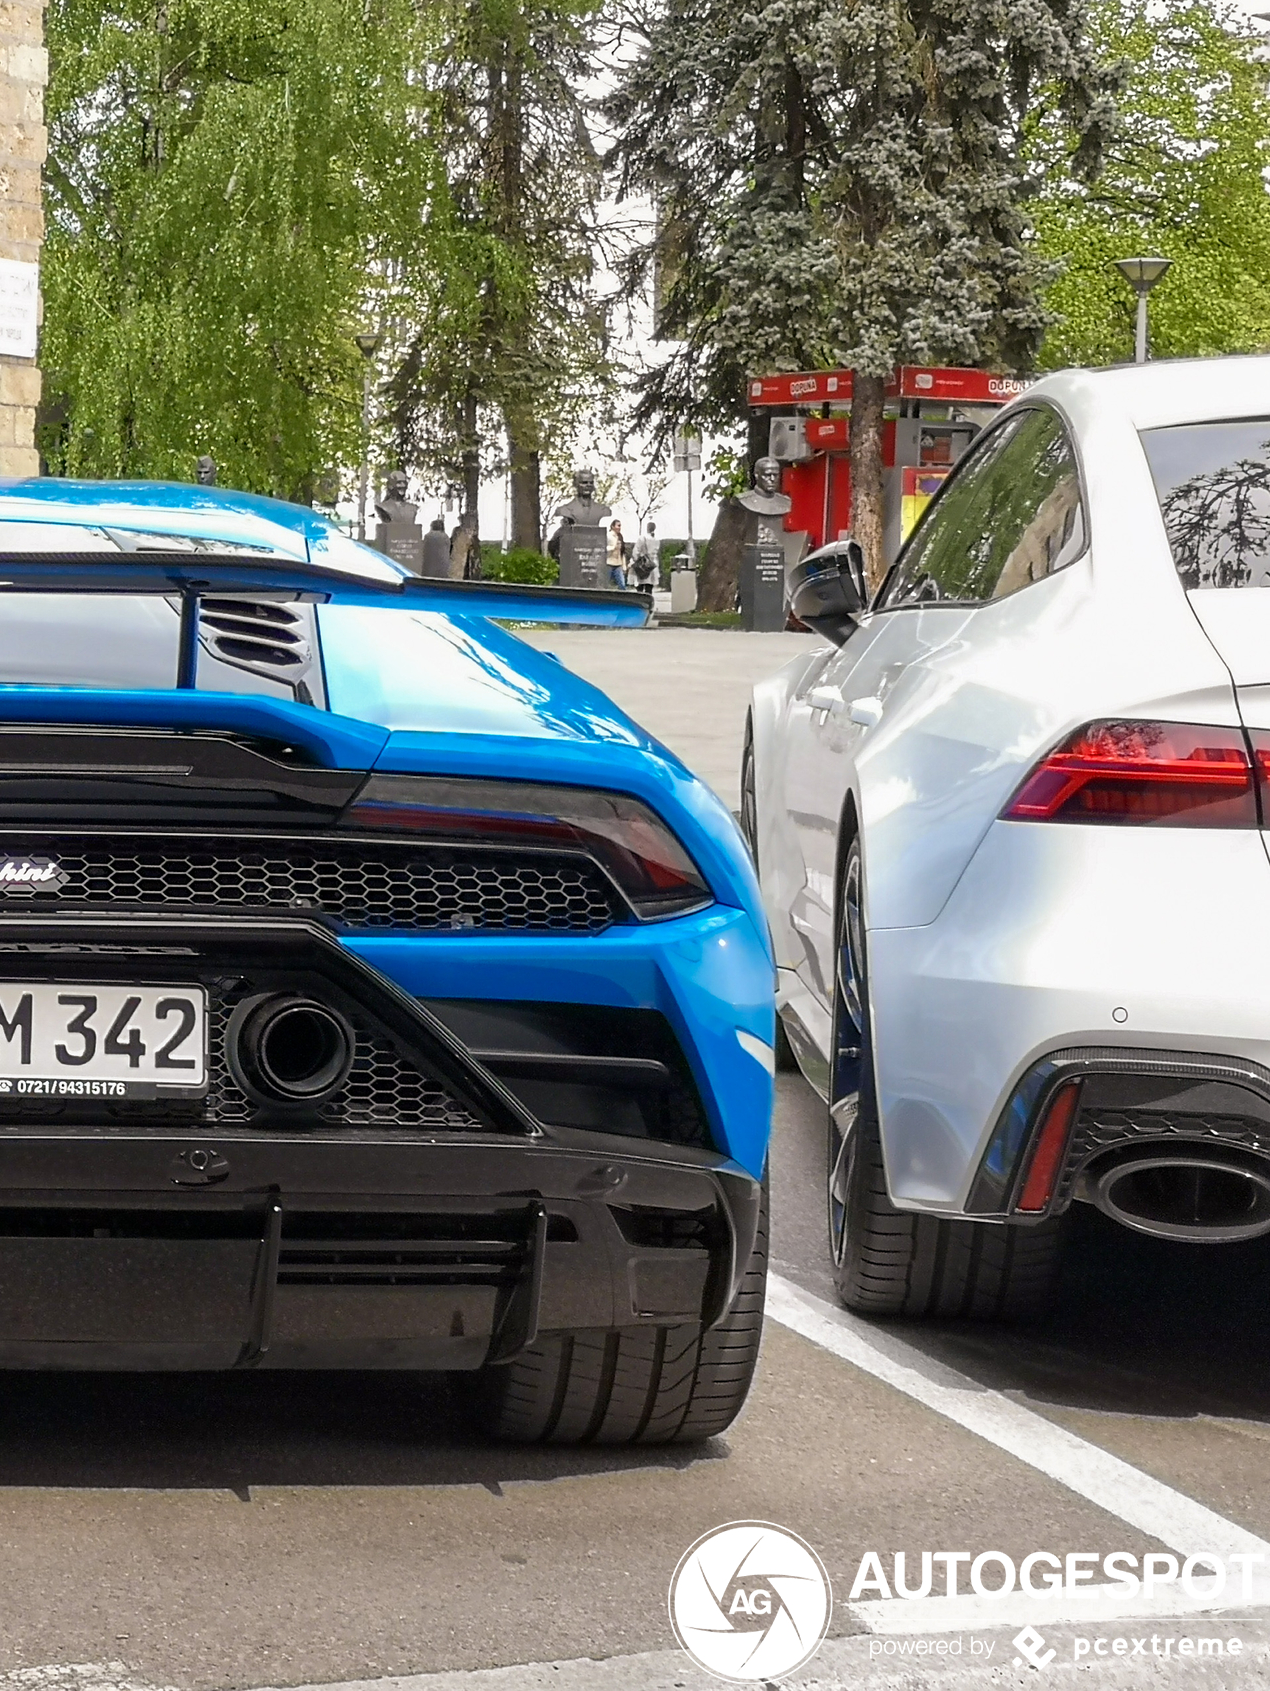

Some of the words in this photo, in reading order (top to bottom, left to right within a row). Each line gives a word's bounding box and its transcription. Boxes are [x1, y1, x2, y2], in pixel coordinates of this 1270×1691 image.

[989, 380, 1033, 392] DOPUN
[55, 992, 196, 1069] 342
[17, 1080, 125, 1095] 0721/94315176
